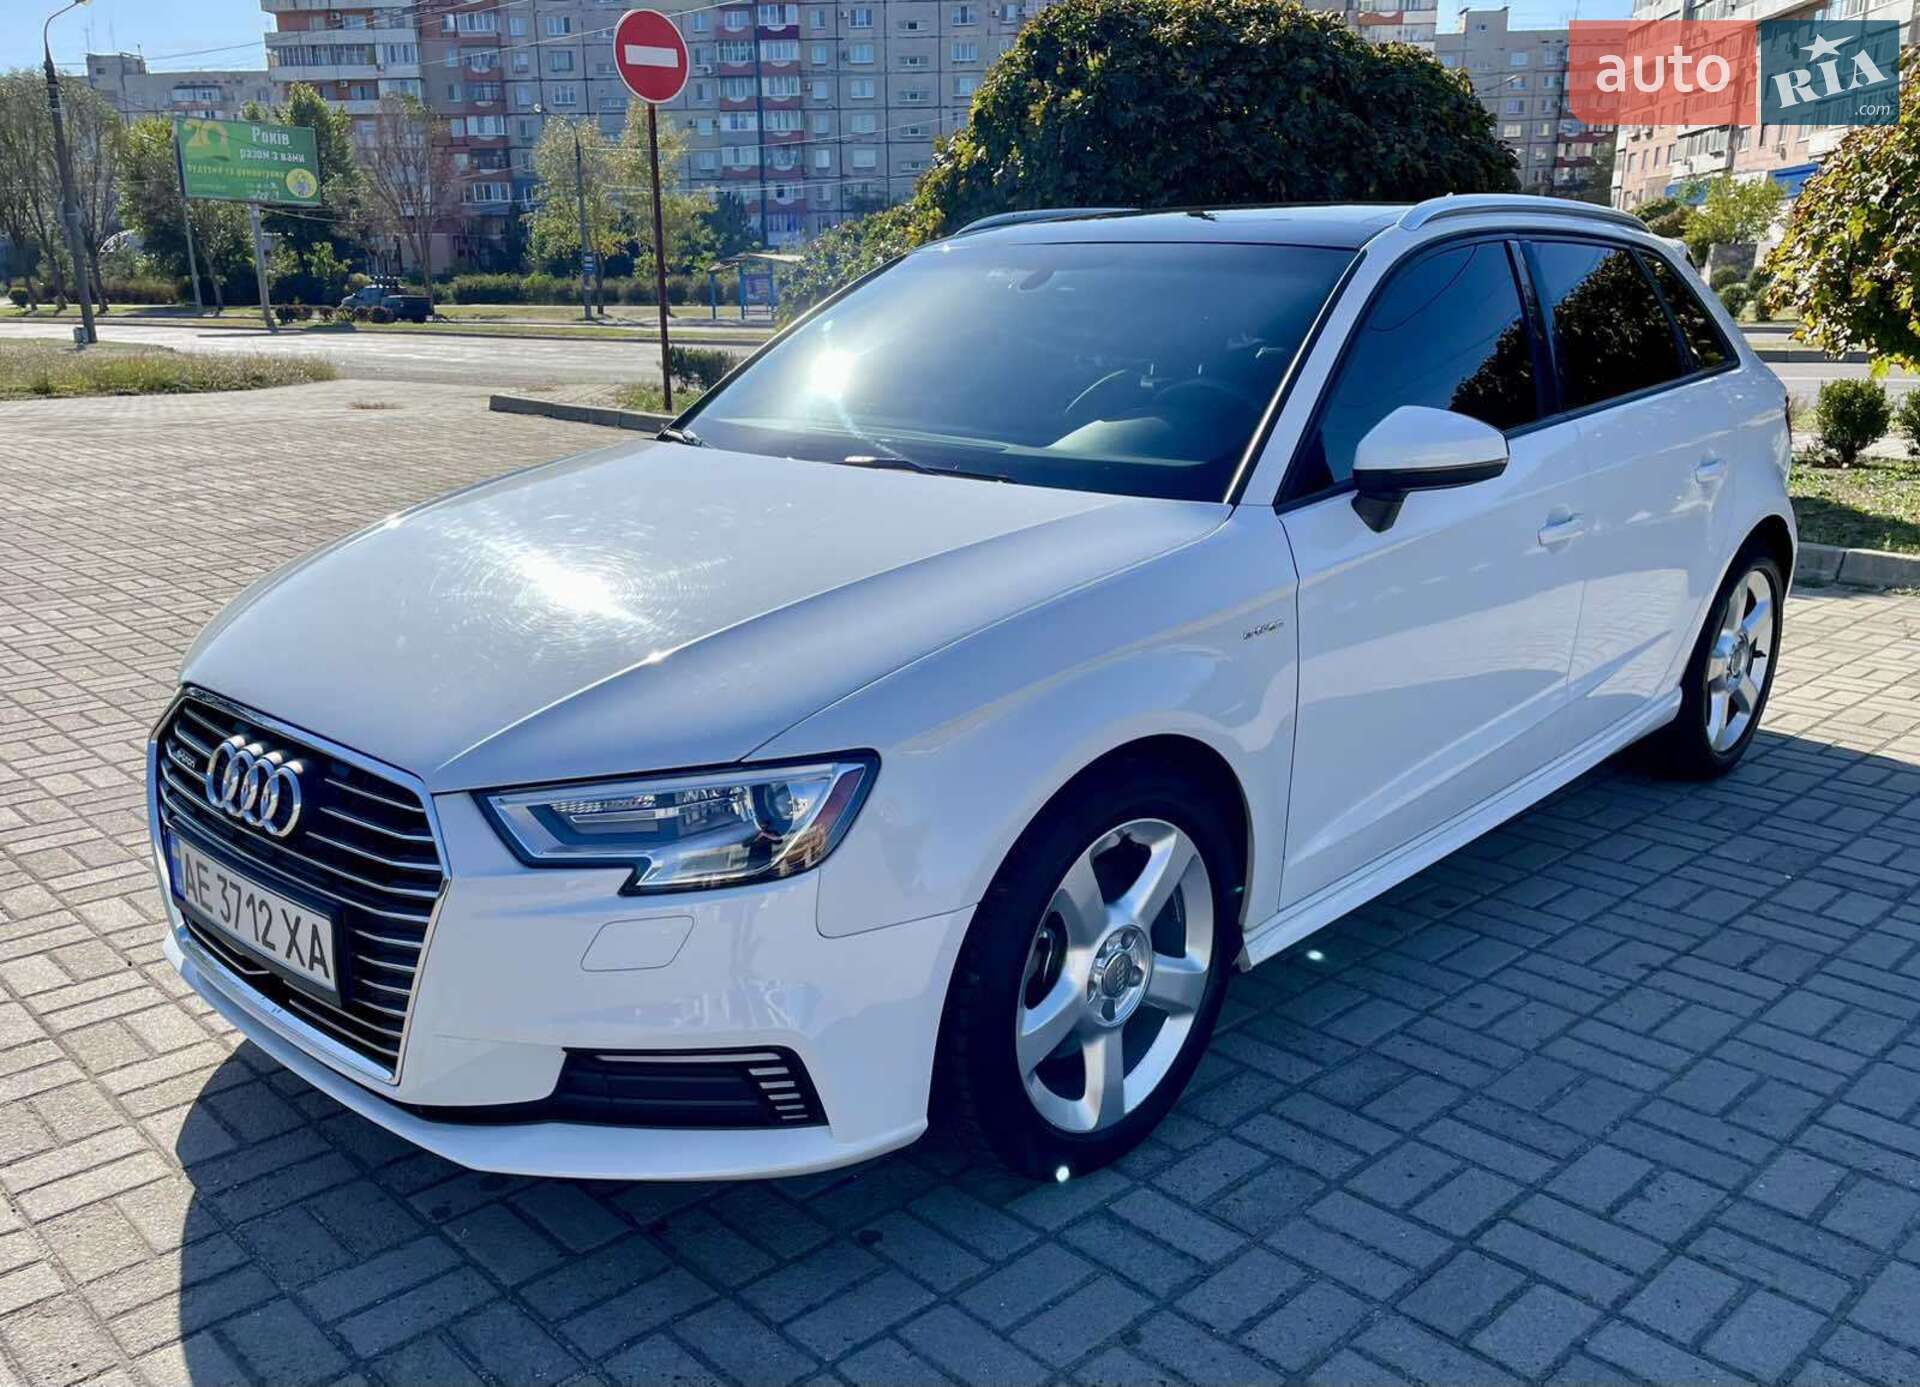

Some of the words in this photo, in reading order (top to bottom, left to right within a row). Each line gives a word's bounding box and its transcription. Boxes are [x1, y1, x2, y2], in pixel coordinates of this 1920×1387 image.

[185, 853, 213, 913] AE
[217, 873, 277, 951] 3712
[281, 908, 330, 979] XA
